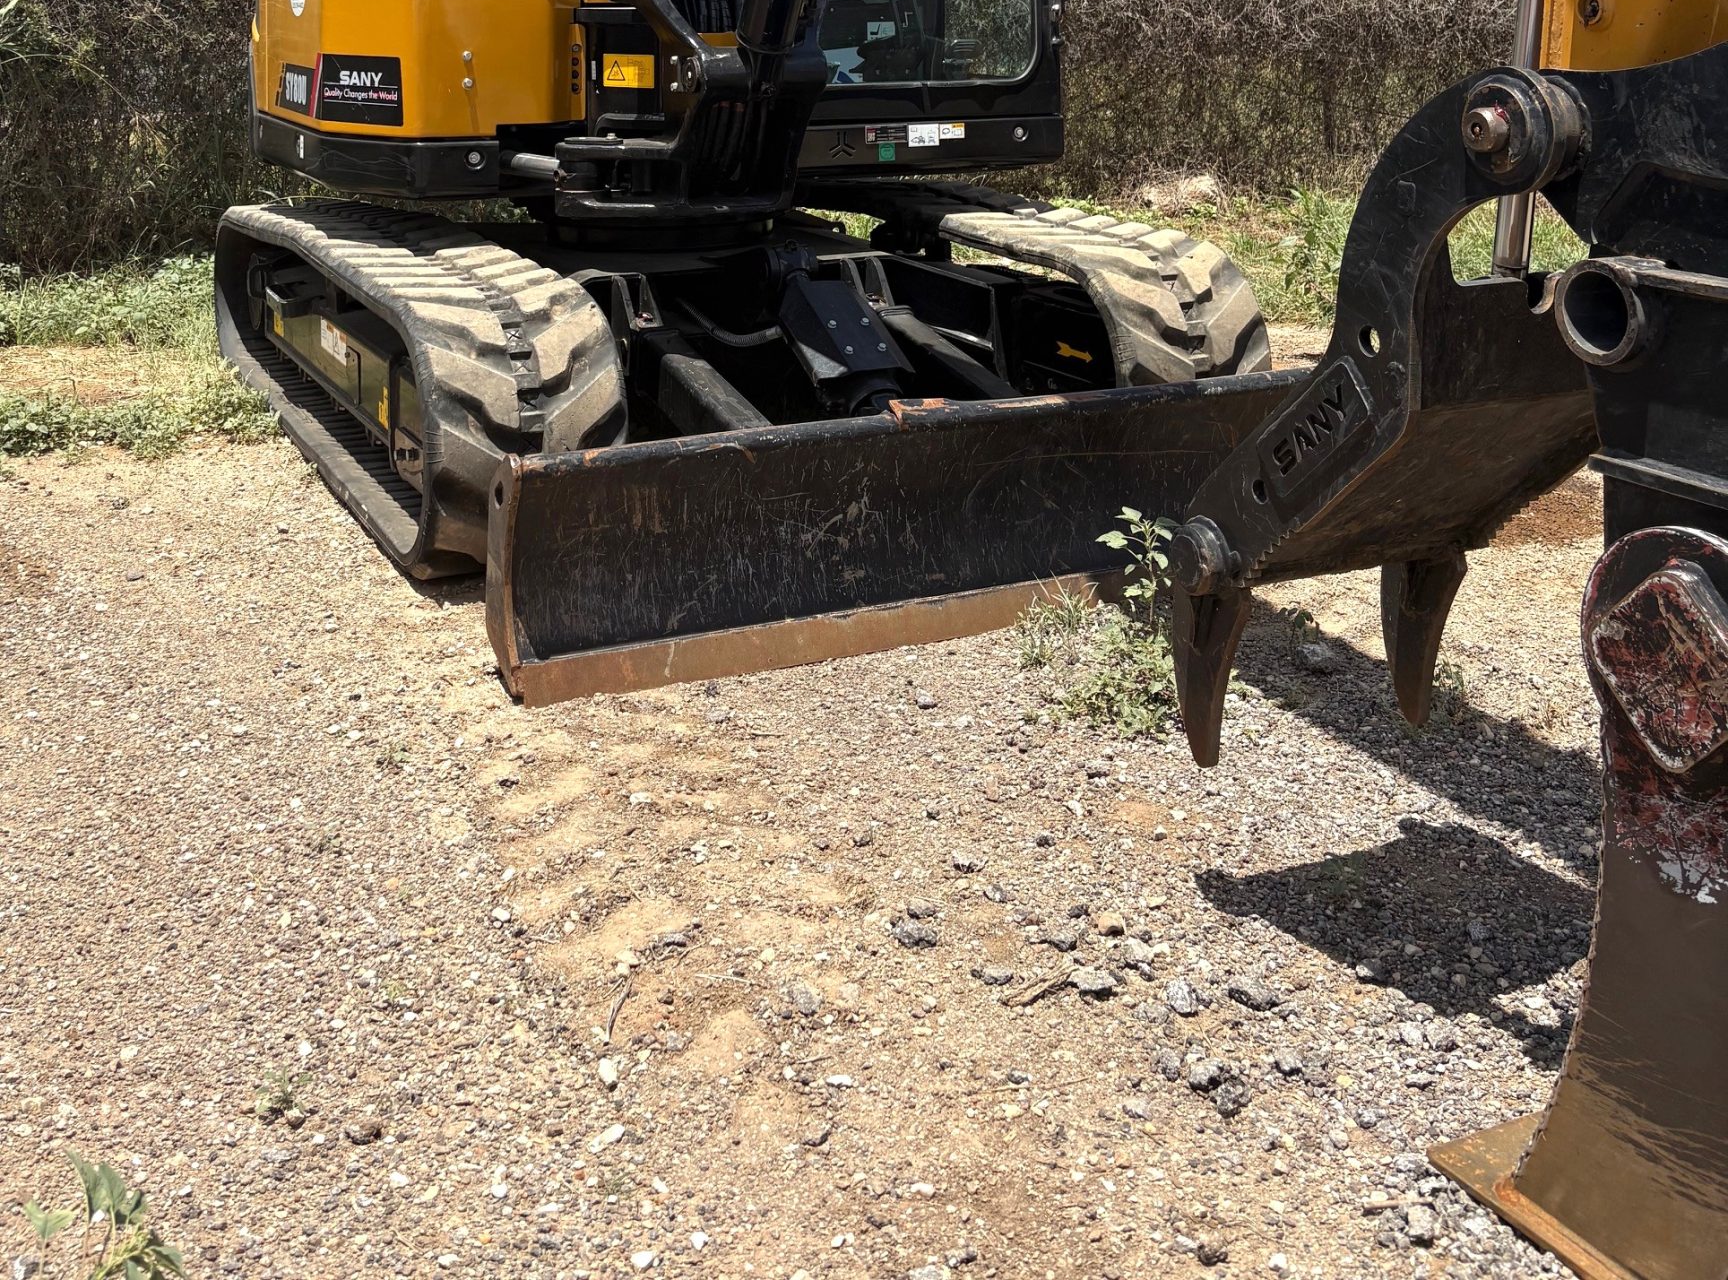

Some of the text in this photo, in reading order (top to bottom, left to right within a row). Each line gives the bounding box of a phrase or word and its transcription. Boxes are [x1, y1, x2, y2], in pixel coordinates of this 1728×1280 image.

[285, 72, 307, 106] SY80U
[340, 70, 382, 87] SANY
[324, 87, 398, 101] Quality Changes the World
[1272, 384, 1346, 477] SANY
